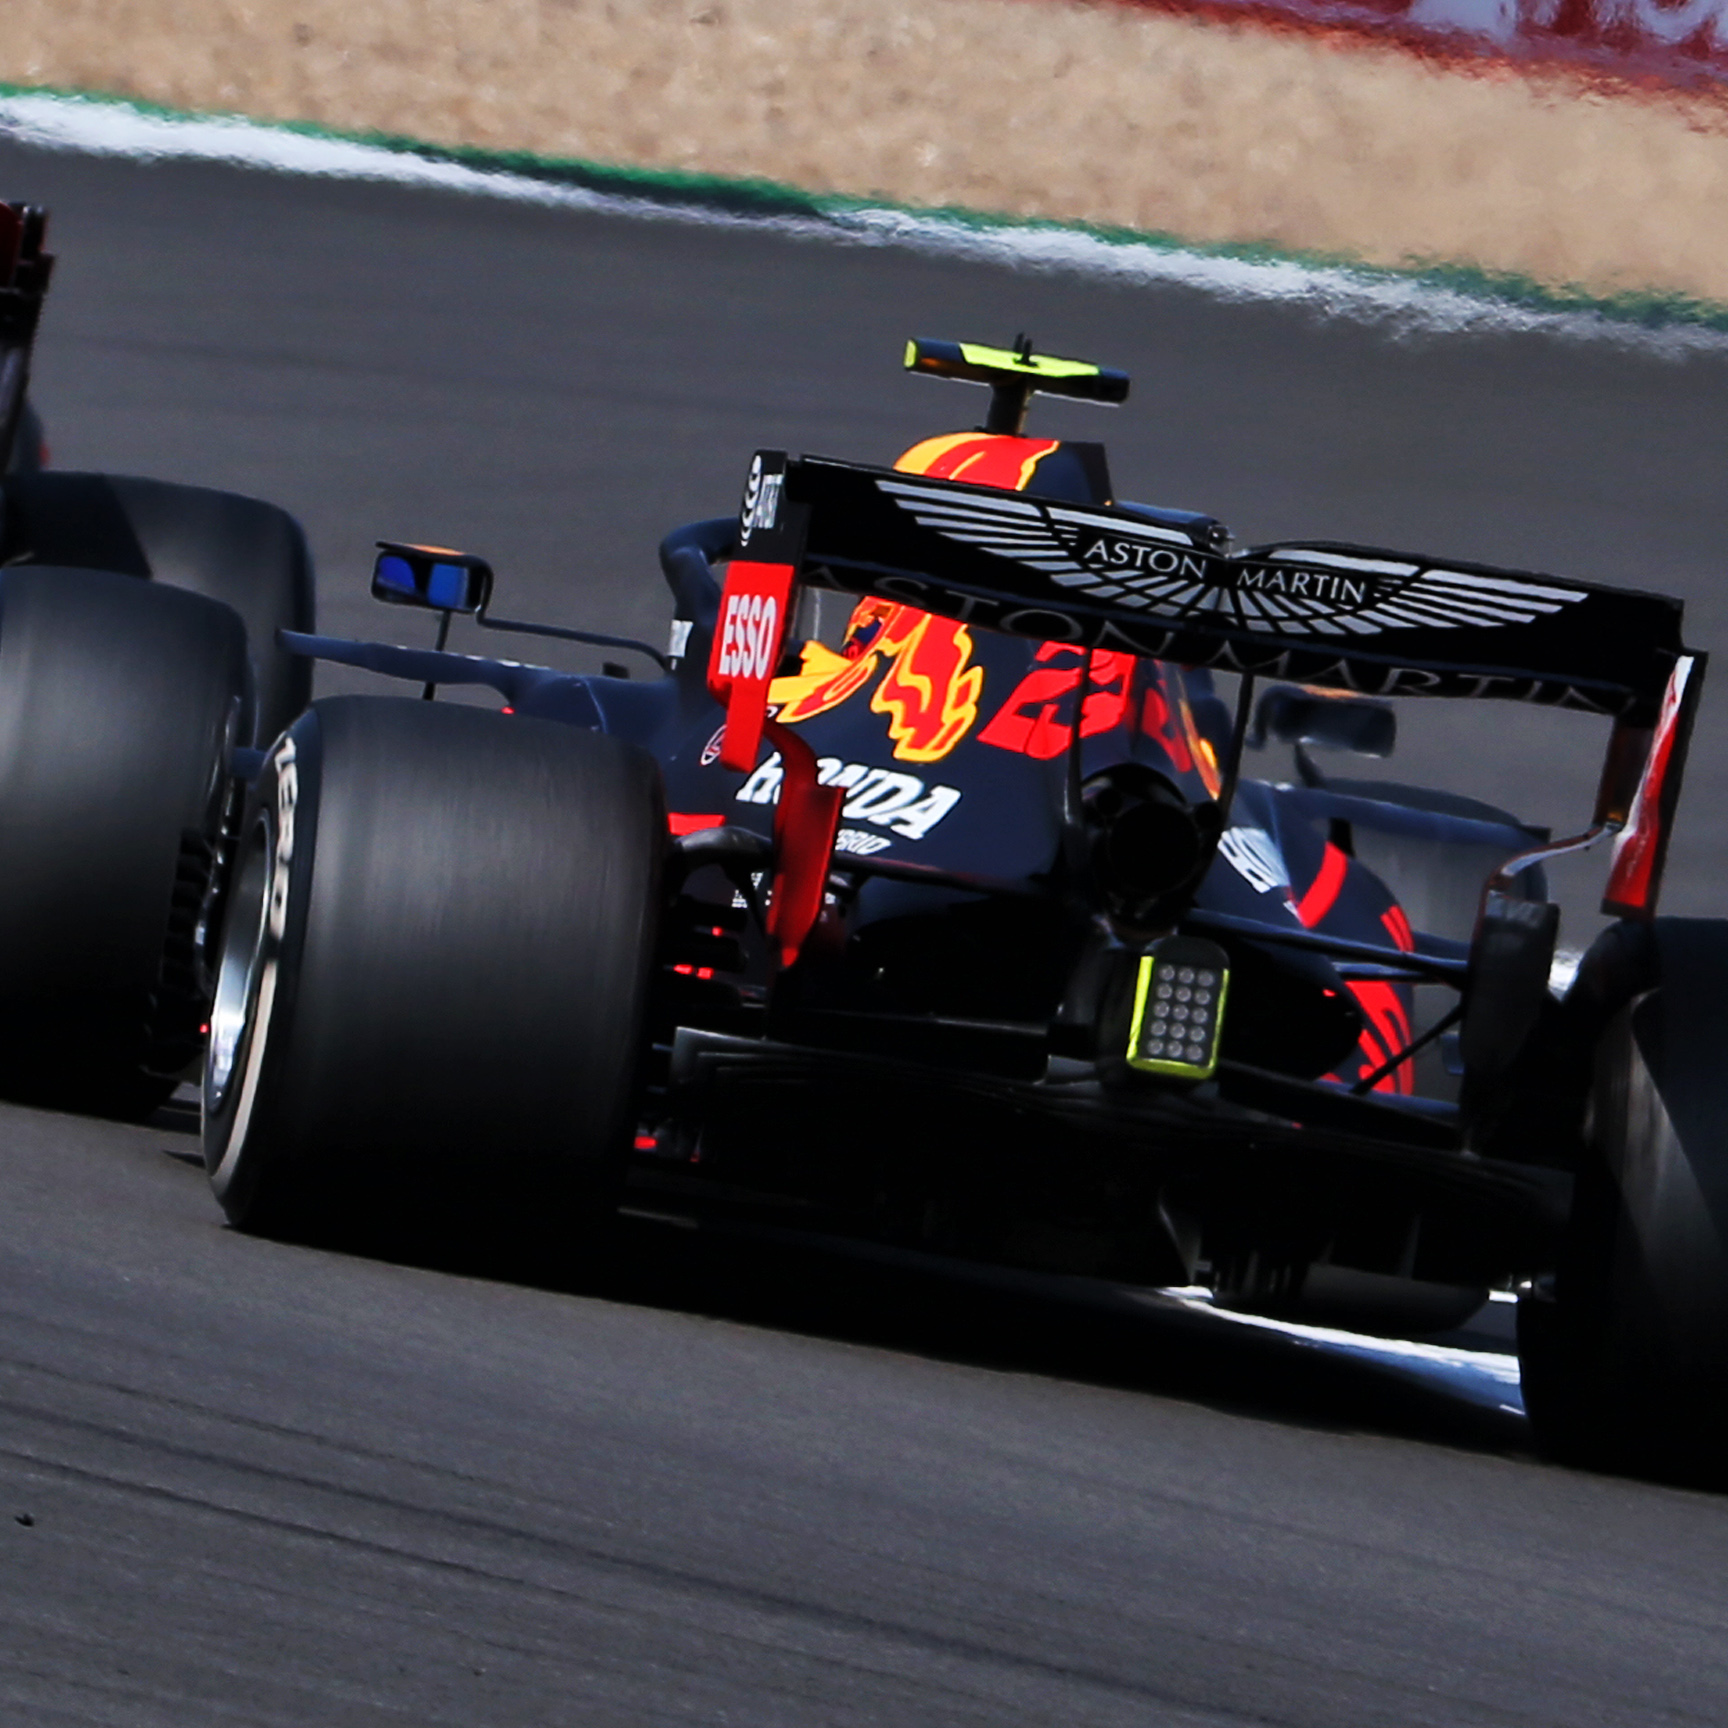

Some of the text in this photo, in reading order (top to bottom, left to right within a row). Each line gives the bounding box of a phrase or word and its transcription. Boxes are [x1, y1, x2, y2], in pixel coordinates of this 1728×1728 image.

[1084, 538, 1367, 604] ASTON MARTIN
[718, 593, 777, 681] ESSO
